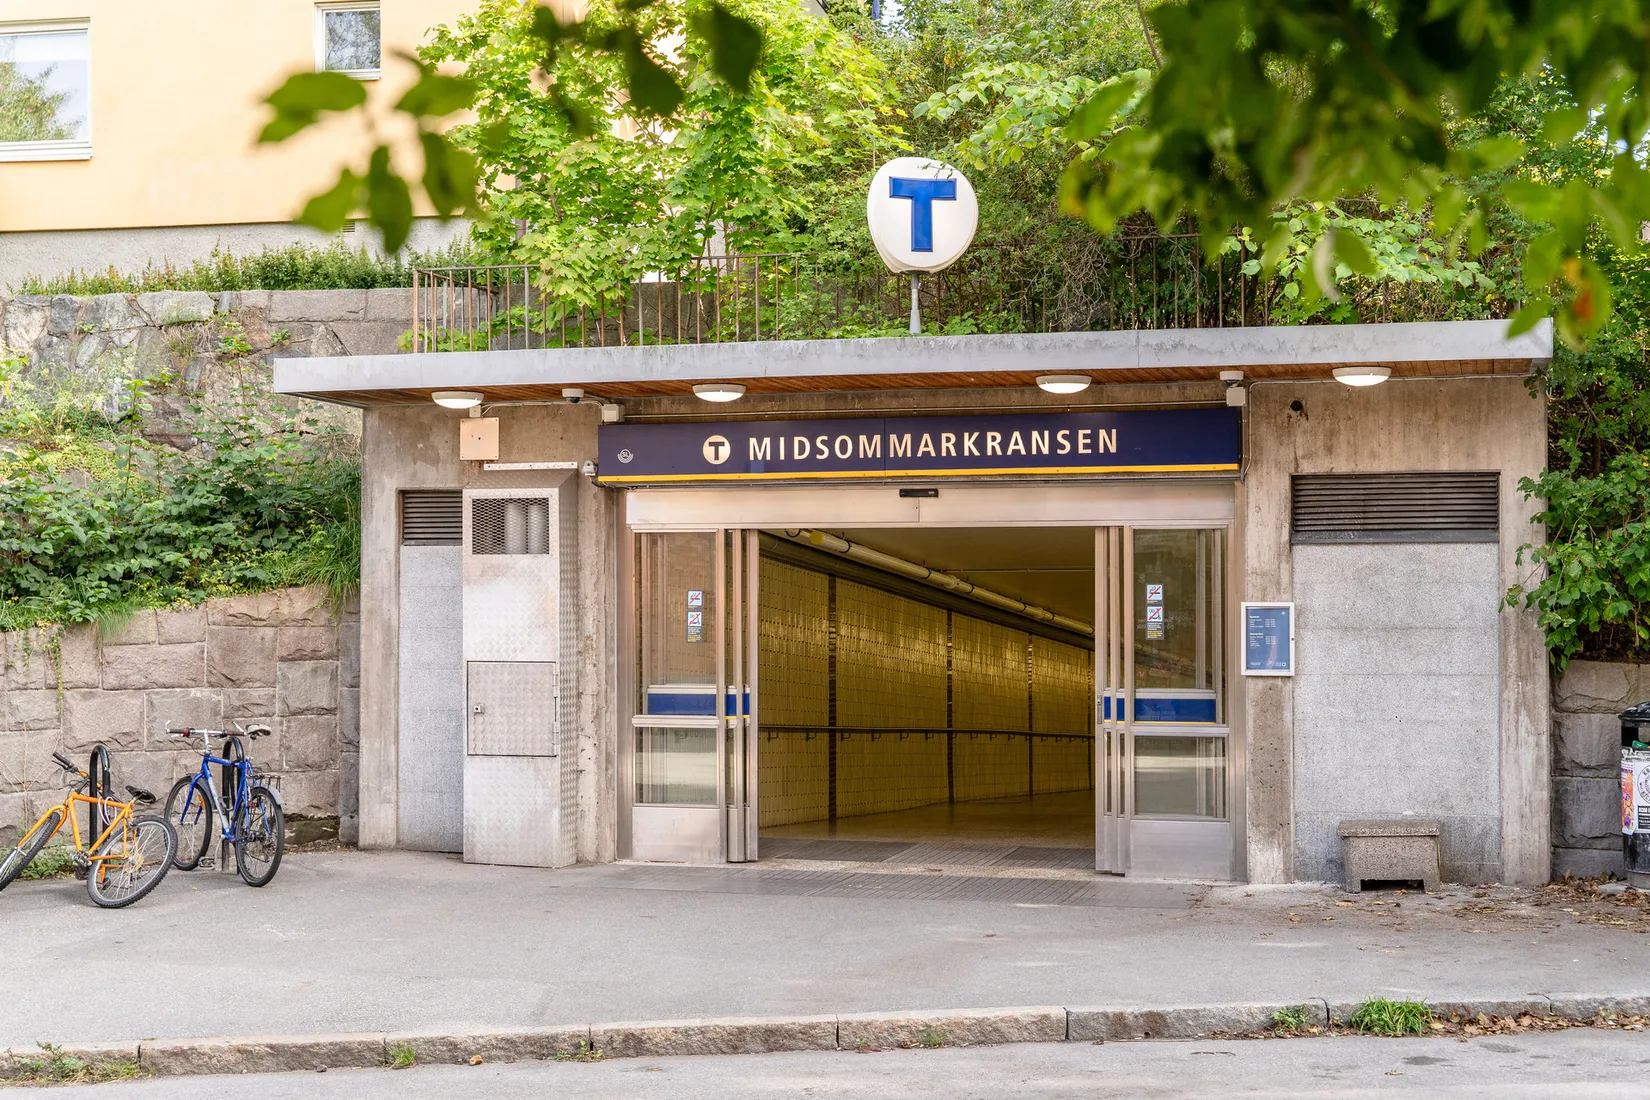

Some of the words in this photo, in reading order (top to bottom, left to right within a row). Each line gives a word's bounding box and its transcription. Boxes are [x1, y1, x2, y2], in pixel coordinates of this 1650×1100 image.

[889, 176, 957, 252] T
[708, 441, 725, 461] T
[749, 428, 1117, 461] MIDSOMMARKRANSEN
